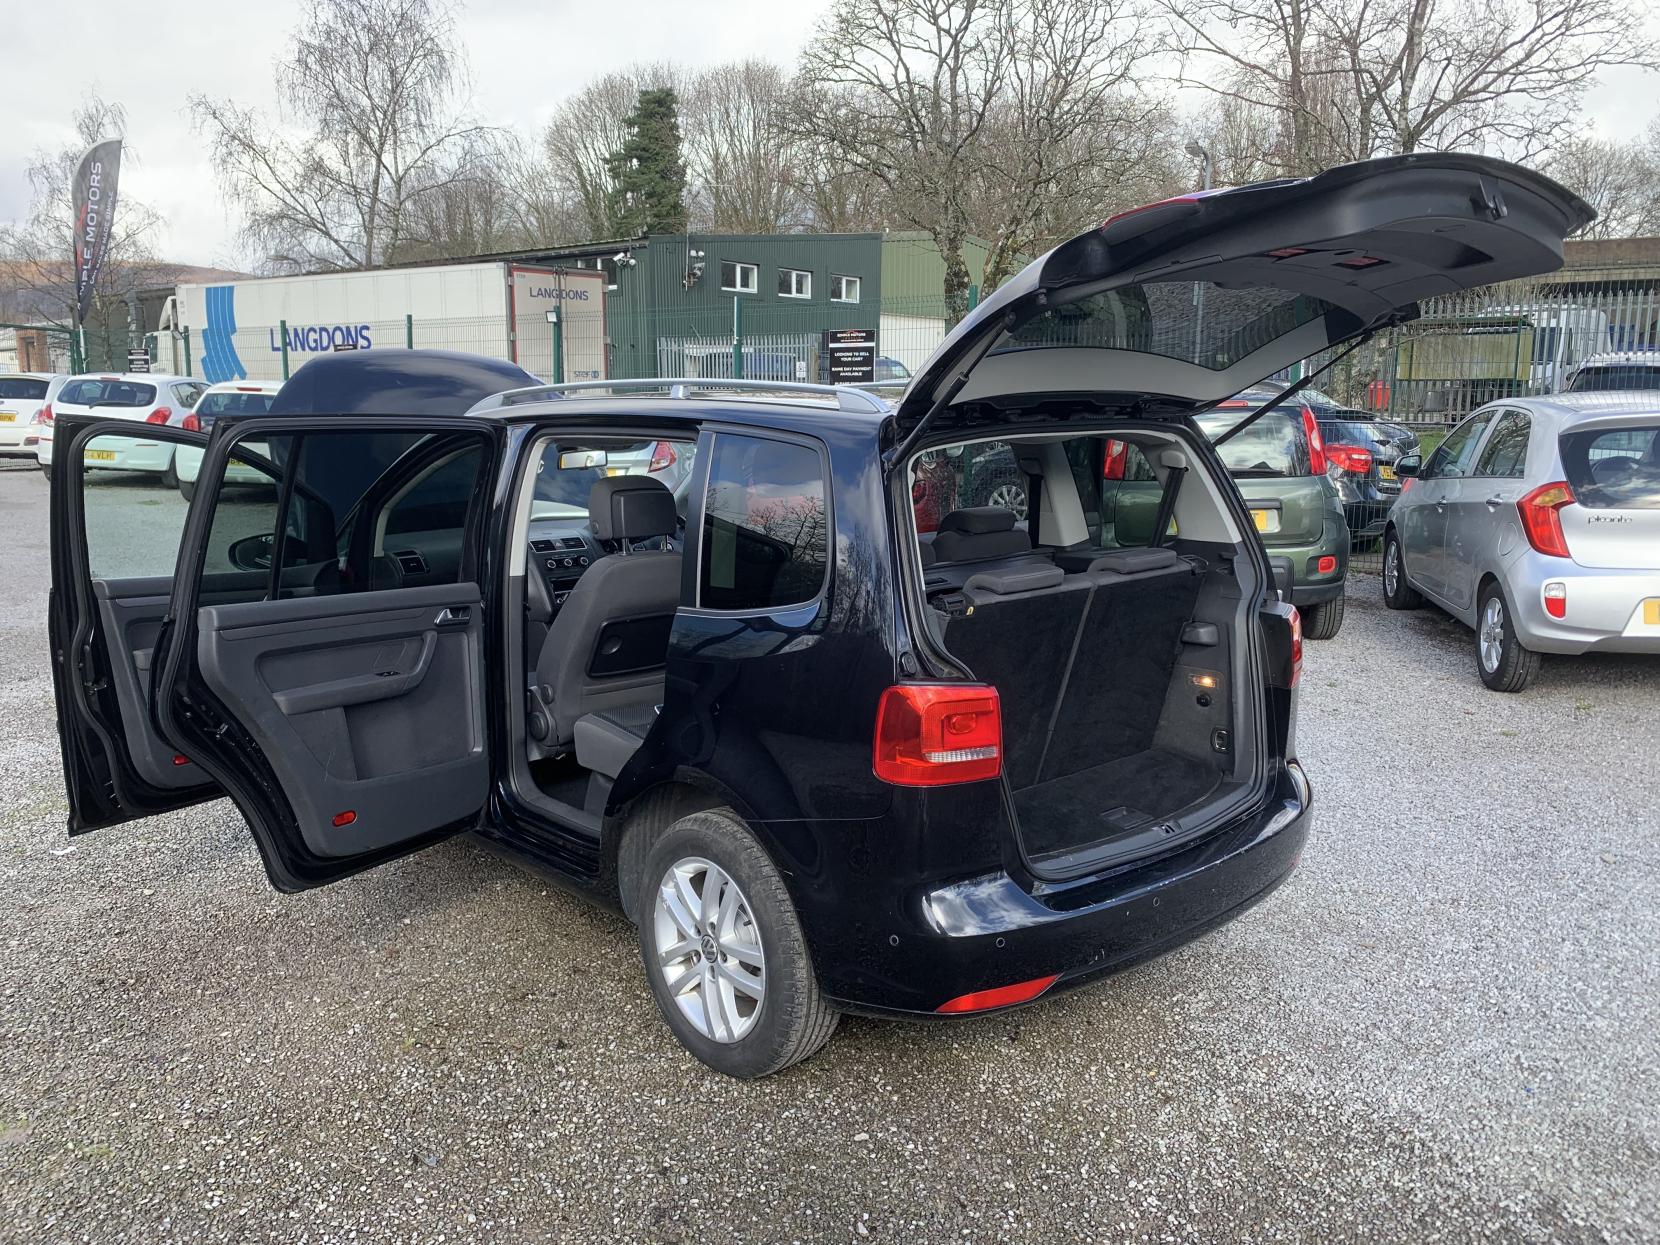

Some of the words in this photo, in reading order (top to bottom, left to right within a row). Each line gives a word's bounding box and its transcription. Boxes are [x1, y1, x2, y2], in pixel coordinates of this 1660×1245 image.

[85, 161, 102, 242] MOTORS
[105, 191, 114, 218] SIMPLE
[102, 219, 110, 244] MADE
[529, 287, 589, 301] LANGDONS
[270, 325, 372, 352] LANGDONS
